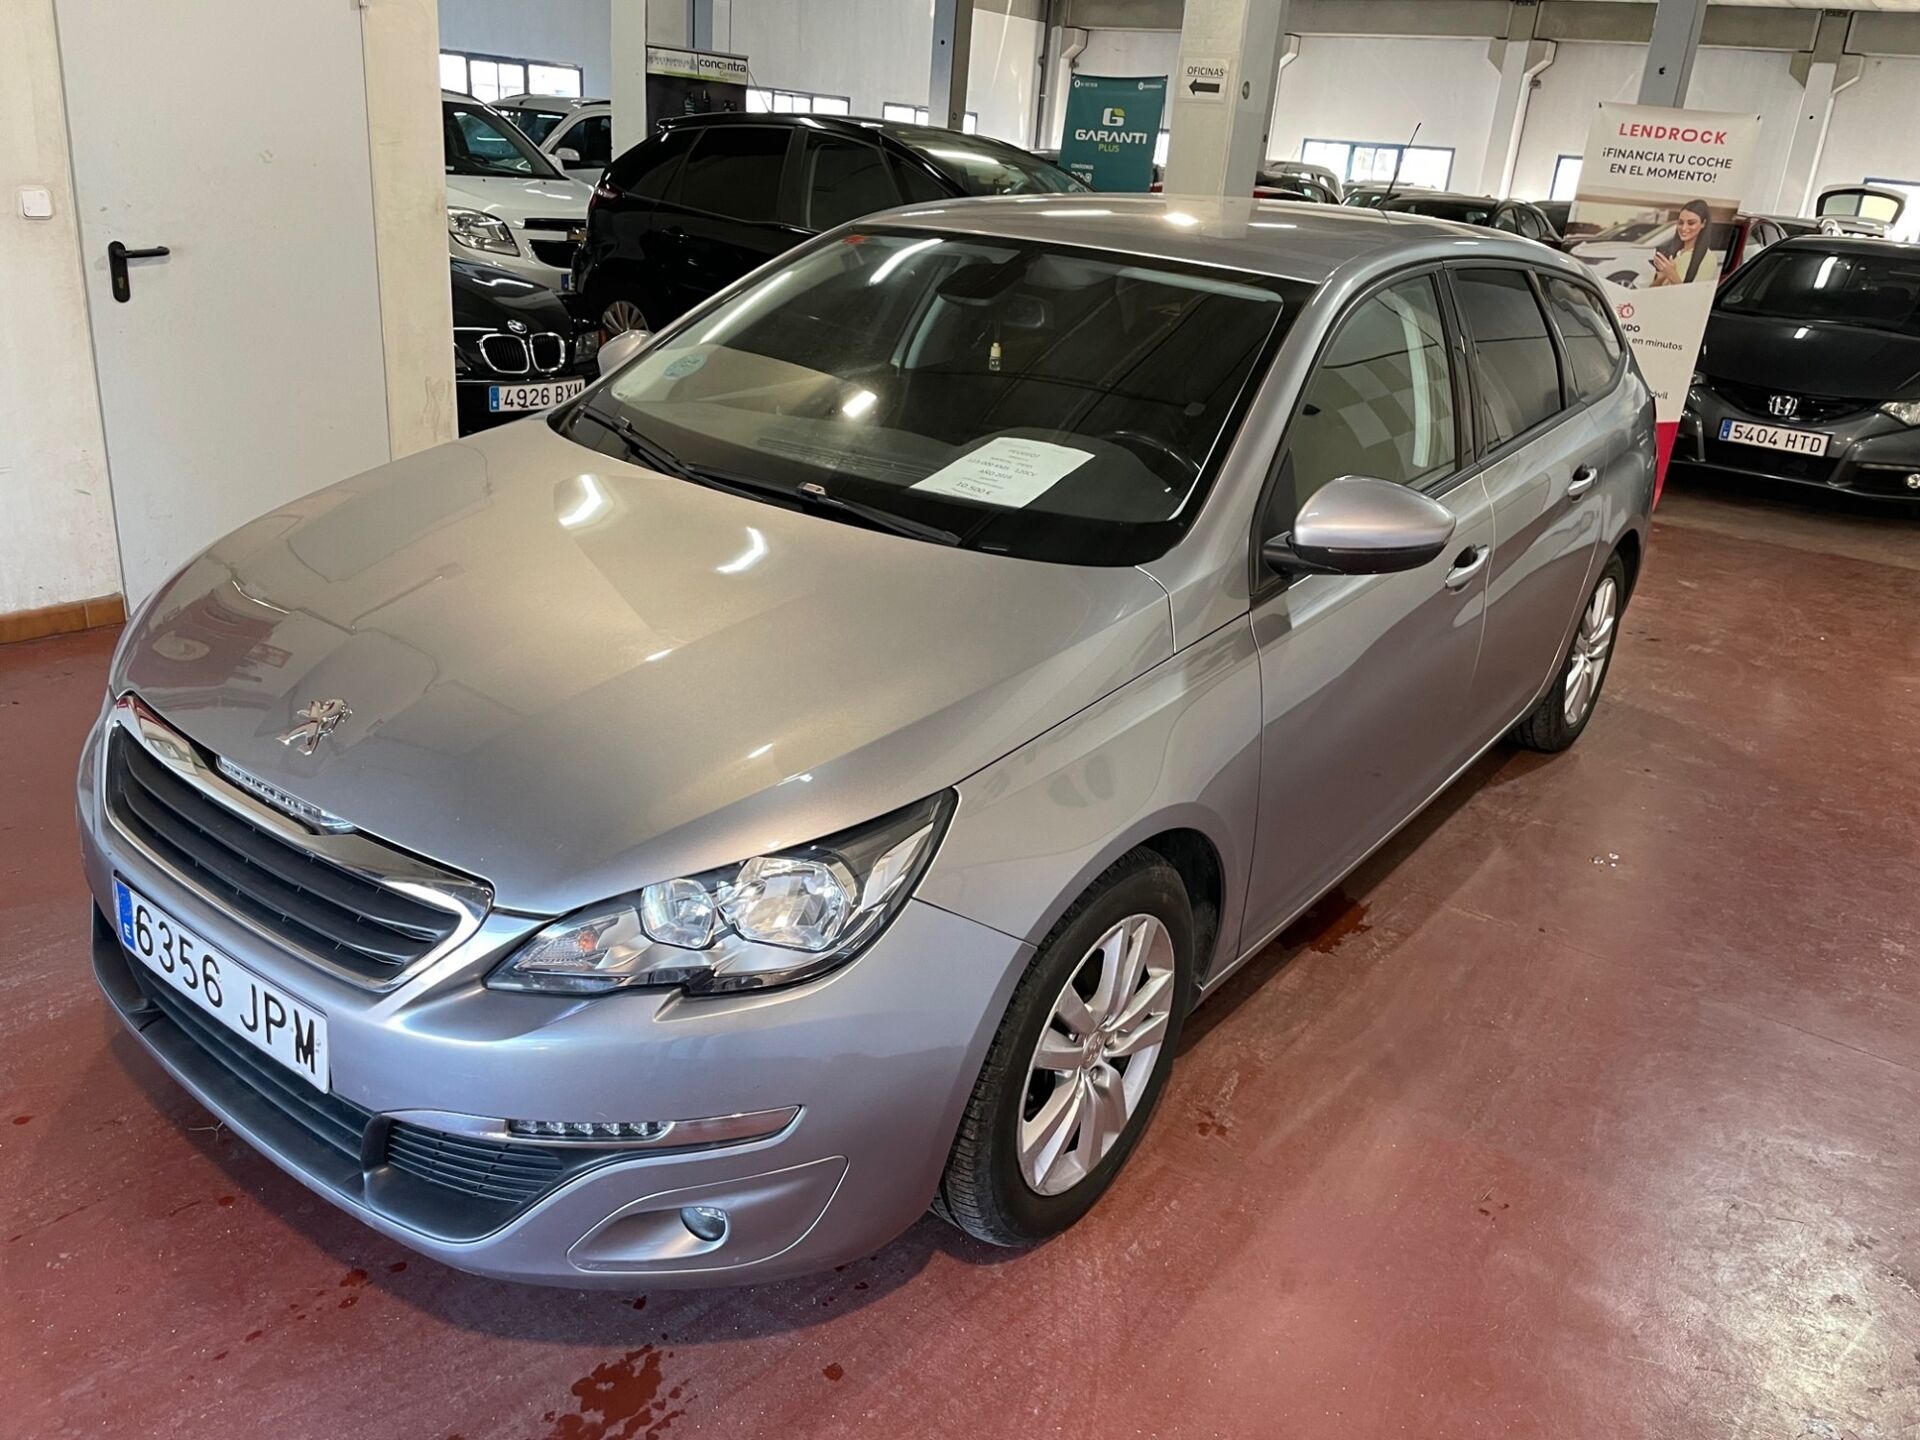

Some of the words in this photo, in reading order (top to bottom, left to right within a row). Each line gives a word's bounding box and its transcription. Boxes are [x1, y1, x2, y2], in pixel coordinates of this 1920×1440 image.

[1187, 65, 1225, 77] OFICINAS
[1074, 128, 1148, 145] GARANTI
[1618, 122, 1728, 145] LENDROCK
[1098, 143, 1120, 153] PLUS
[1602, 147, 1665, 163] ¡FINANCIA
[1668, 153, 1685, 164] TU
[1687, 155, 1734, 169] COCHE
[1609, 163, 1628, 174] EN
[1629, 165, 1644, 176] EL
[1646, 167, 1717, 183] MOMENTO!
[1631, 338, 1645, 346] en
[1645, 338, 1683, 351] minutos
[503, 387, 551, 409] 4926
[1732, 424, 1779, 447] 5404
[1784, 432, 1822, 454] HTD
[135, 904, 224, 1009] 6356
[240, 983, 316, 1075] JPM
